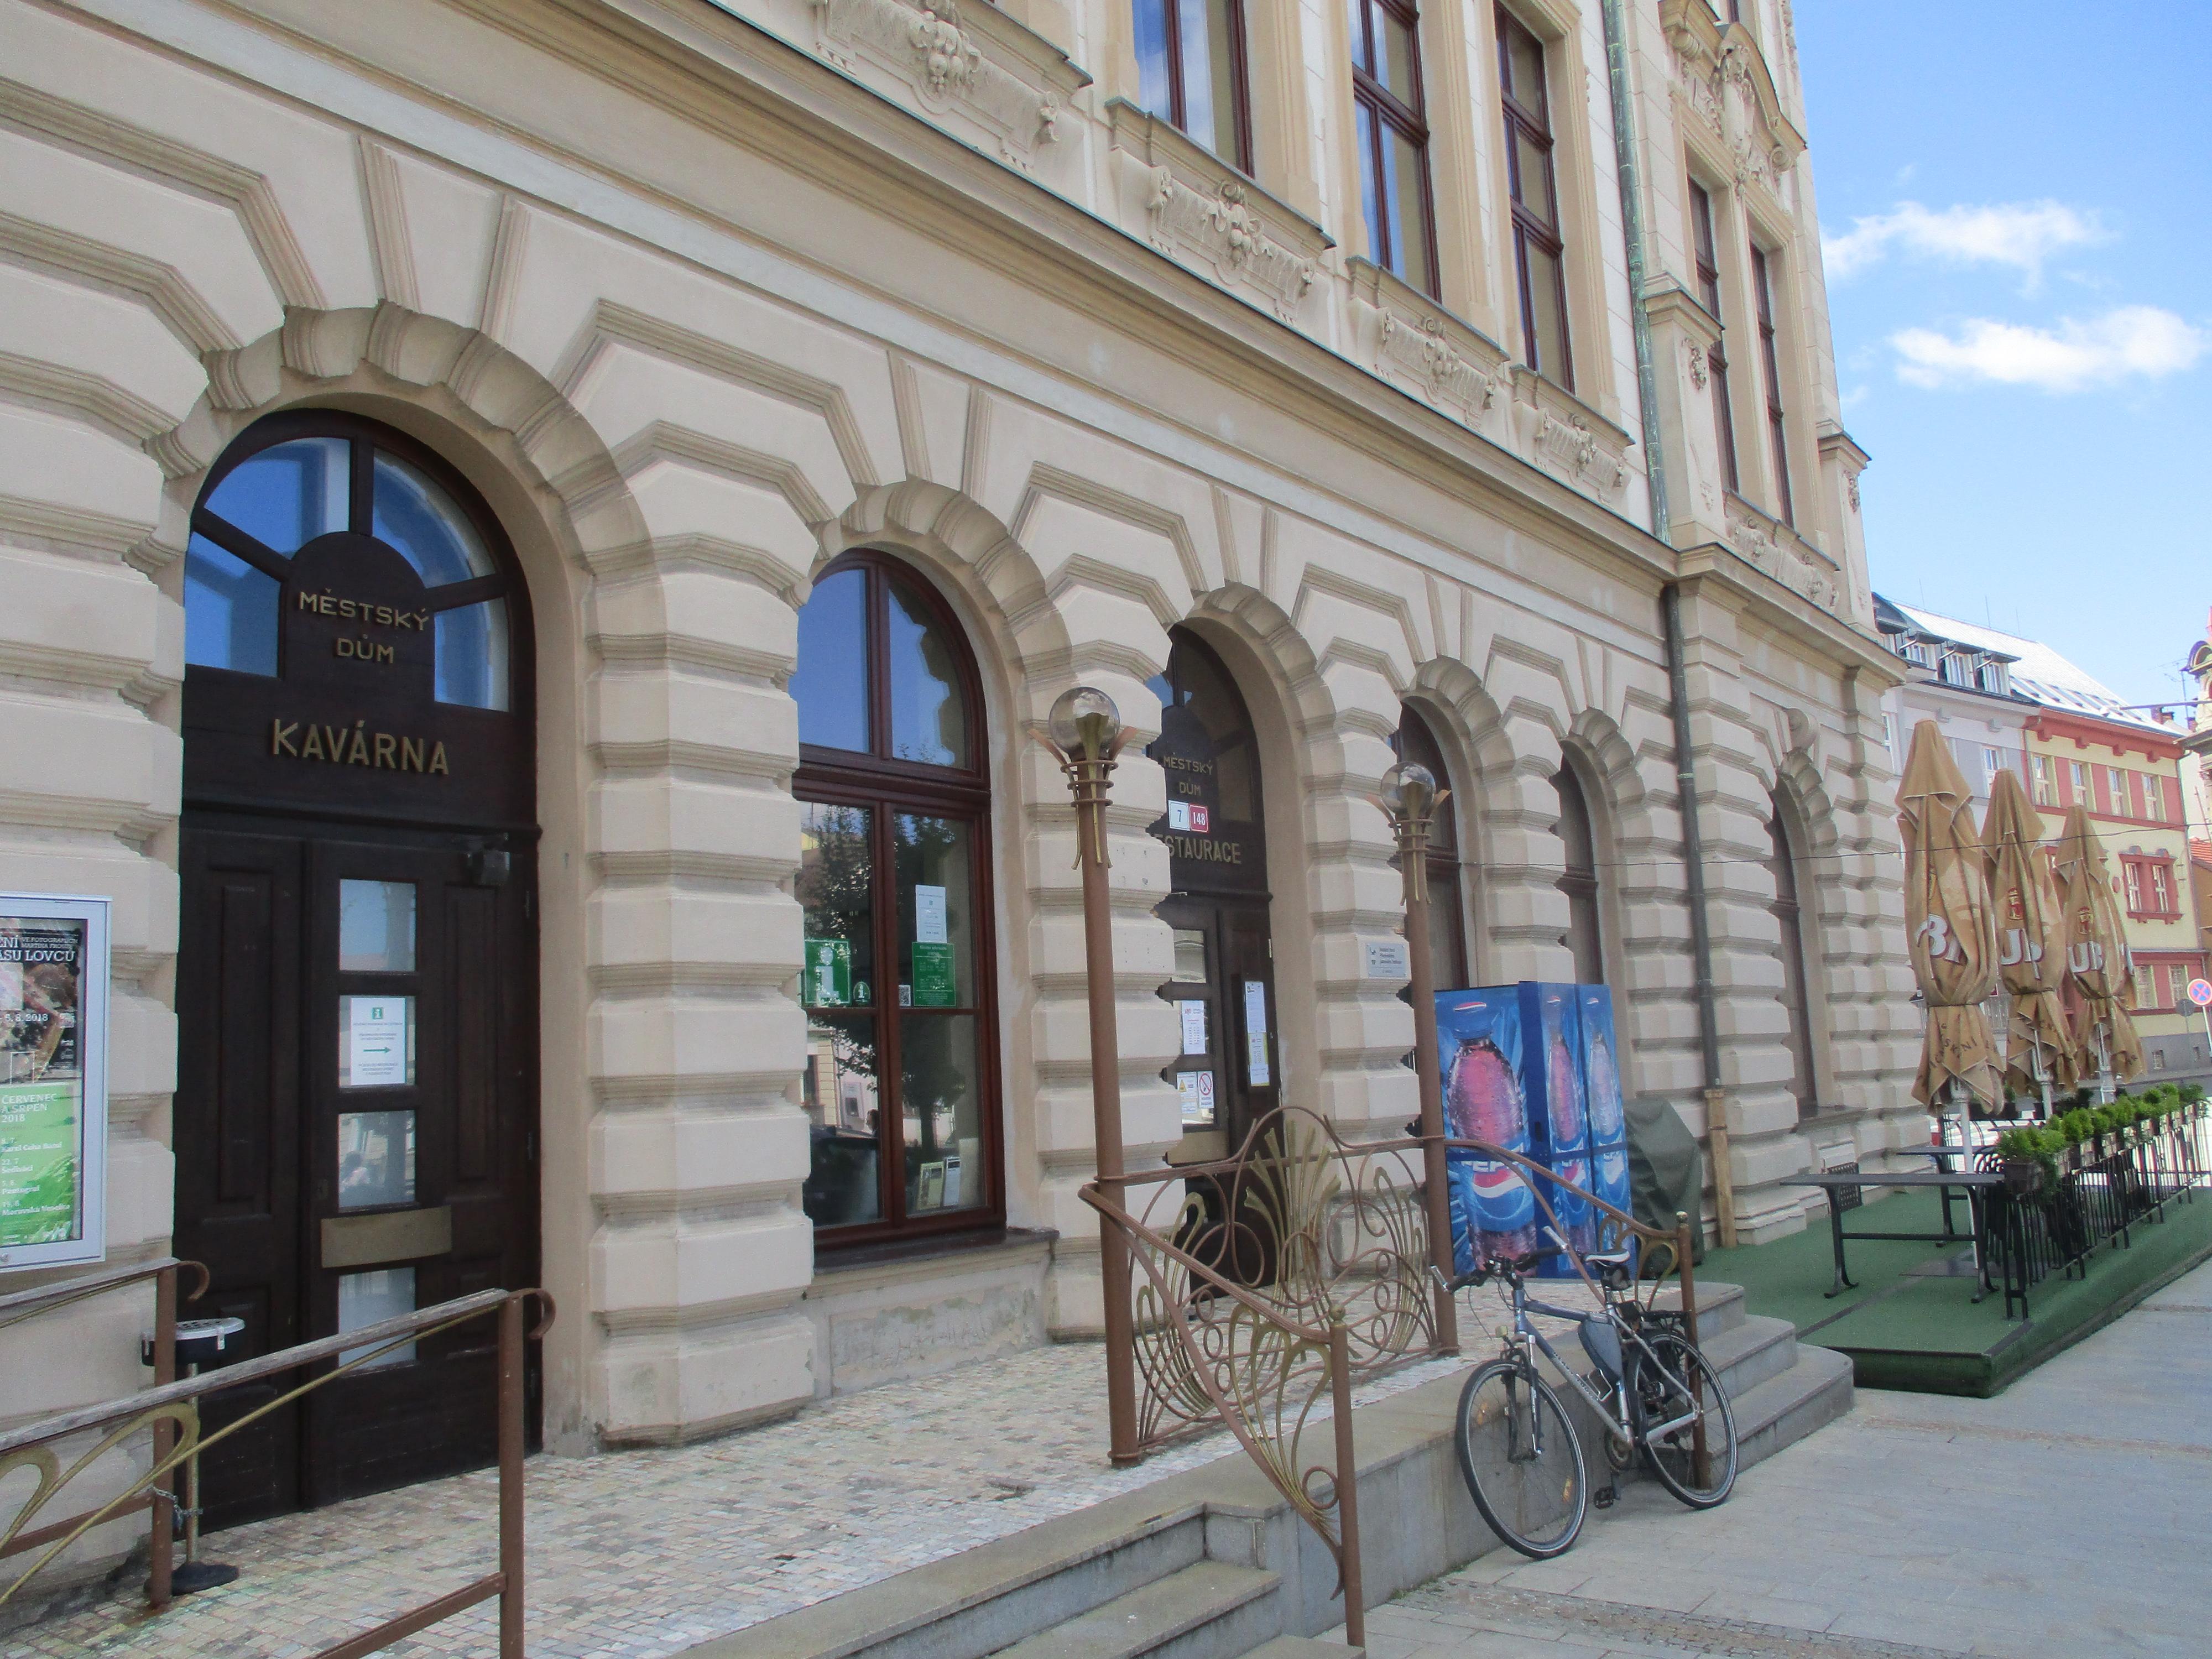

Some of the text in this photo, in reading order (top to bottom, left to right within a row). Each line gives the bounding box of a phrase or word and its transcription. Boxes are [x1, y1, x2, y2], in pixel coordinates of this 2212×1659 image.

[299, 588, 429, 632] MĚSTSKÝ
[336, 634, 394, 664] DŮM
[273, 718, 449, 775] KAVÁRNA
[1163, 752, 1213, 775] MĚSTSKÝ
[1177, 810, 1206, 826] 7 148
[1154, 834, 1242, 864] STAURACE
[25, 1013, 49, 1022] 2018
